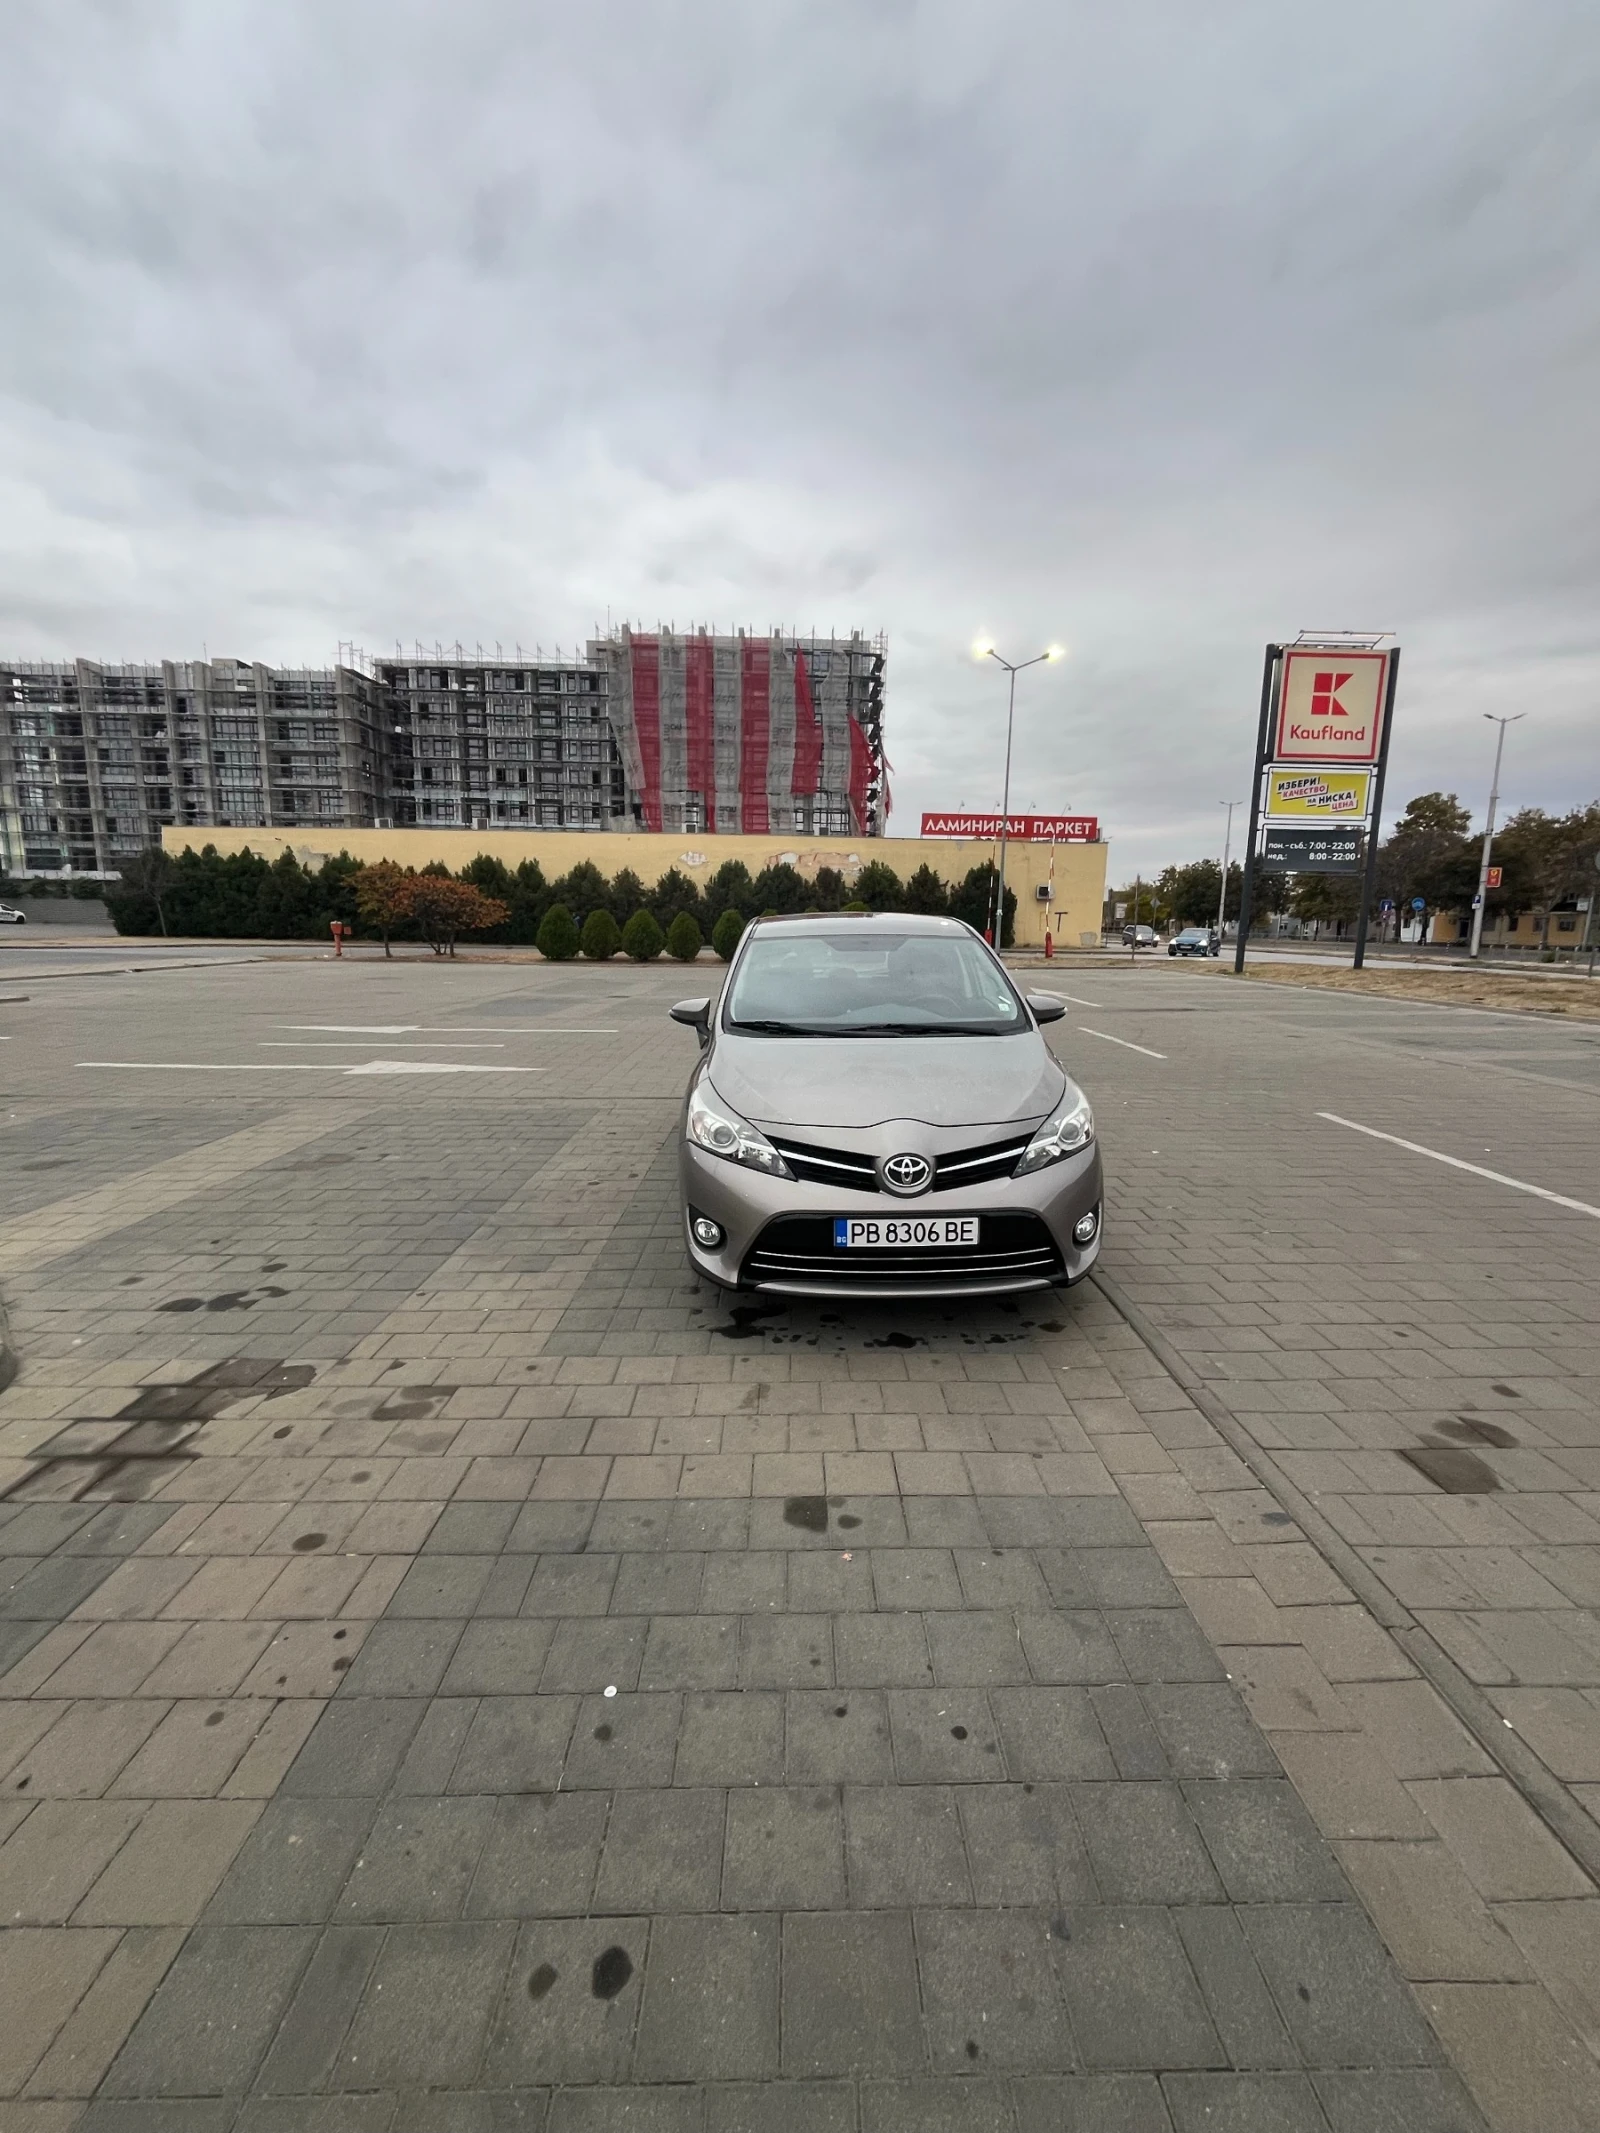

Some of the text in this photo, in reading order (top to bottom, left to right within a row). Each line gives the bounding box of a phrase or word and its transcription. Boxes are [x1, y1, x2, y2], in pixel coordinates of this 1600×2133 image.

[1290, 724, 1366, 741] Kaufland
[1282, 785, 1326, 798] КАЧЕСТВО
[1331, 800, 1355, 810] ЦЕНА
[925, 818, 1093, 835] ЛАМИНИРАН ПАРКЕТ
[851, 1222, 880, 1244] PB
[885, 1221, 940, 1244] 8306
[945, 1221, 974, 1242] BE
